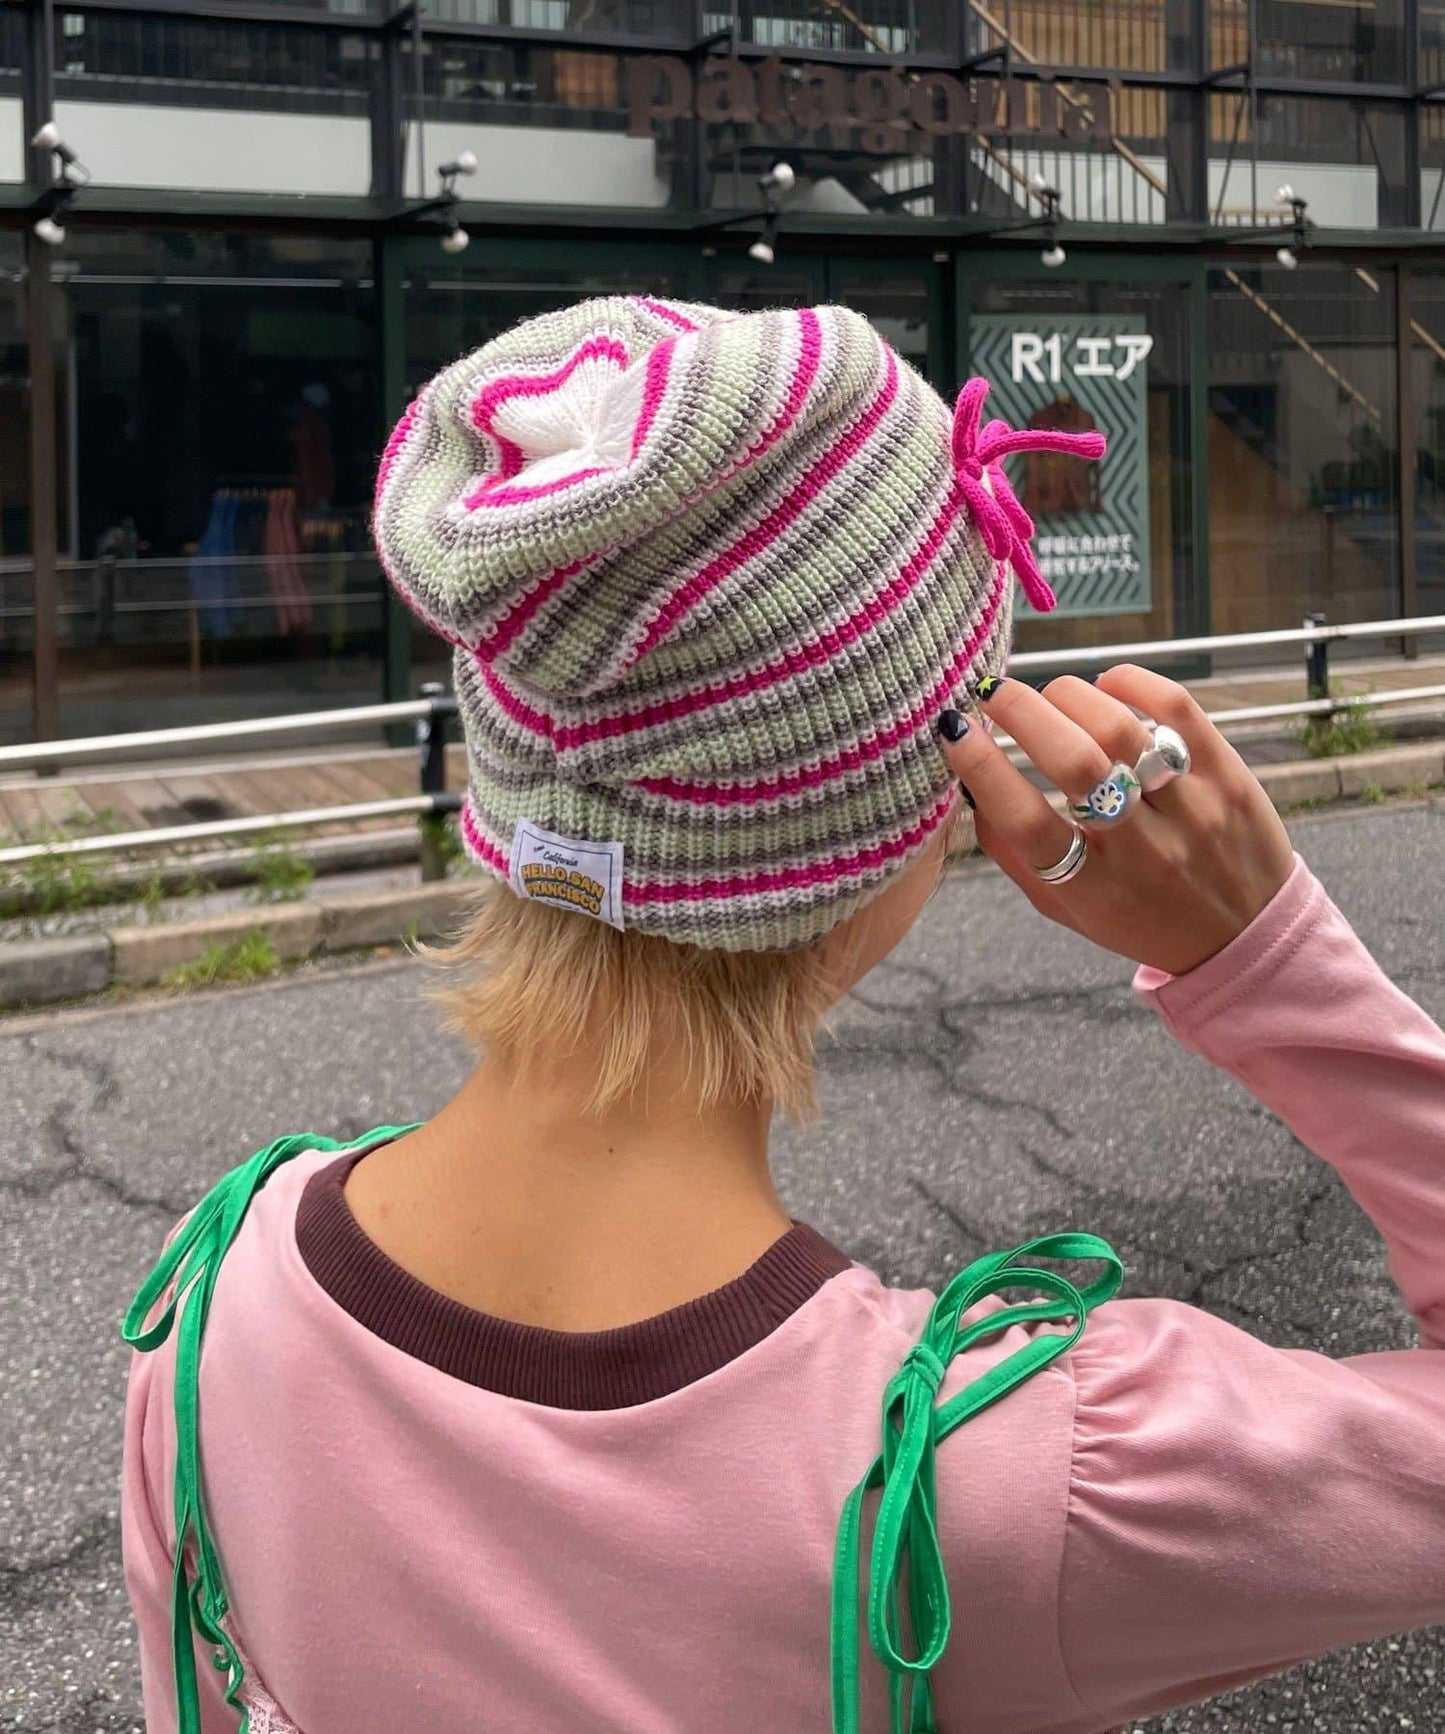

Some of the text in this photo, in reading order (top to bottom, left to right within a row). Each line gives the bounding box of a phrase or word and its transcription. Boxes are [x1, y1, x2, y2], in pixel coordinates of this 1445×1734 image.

[625, 51, 1116, 152] patagonia
[1011, 331, 1154, 383] R1 エア
[521, 863, 606, 902] HELLO SAN
